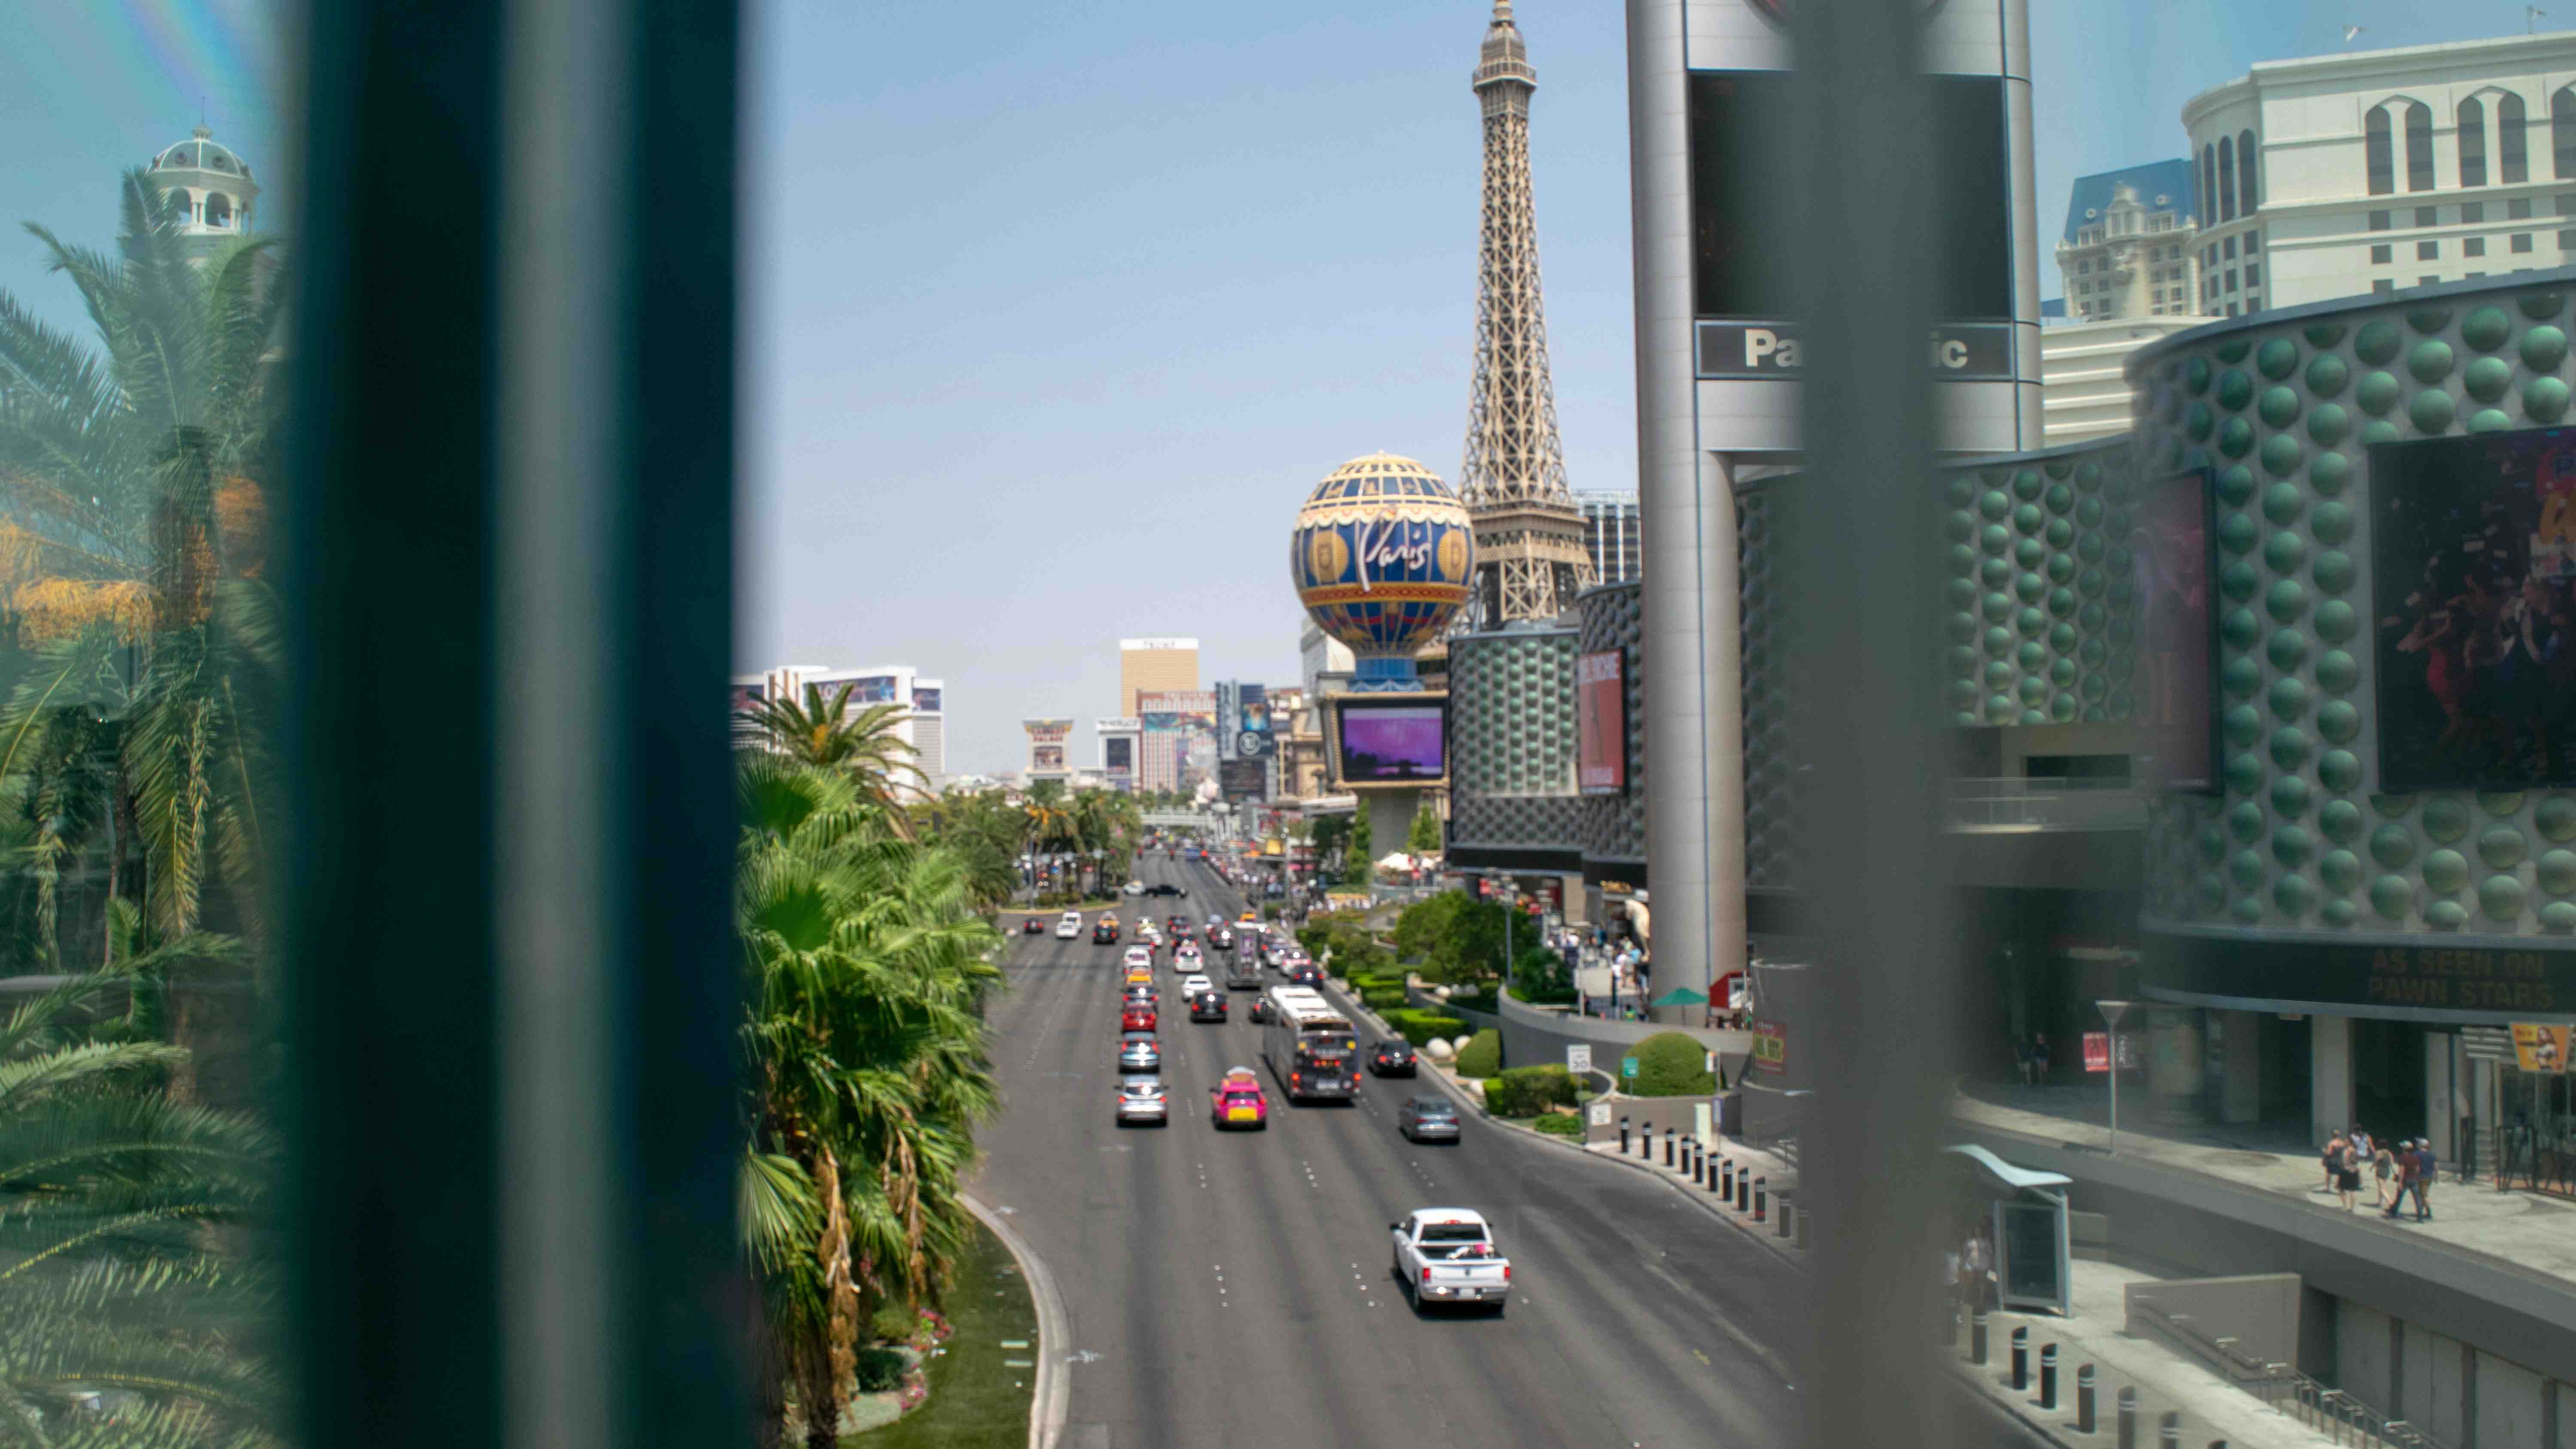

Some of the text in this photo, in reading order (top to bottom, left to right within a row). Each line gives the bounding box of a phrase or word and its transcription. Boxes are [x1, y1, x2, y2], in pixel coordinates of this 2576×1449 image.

[1358, 507, 1432, 591] Paris
[2372, 948, 2545, 978] AS SEEN ON
[2369, 976, 2555, 1009] PAWN STARS
